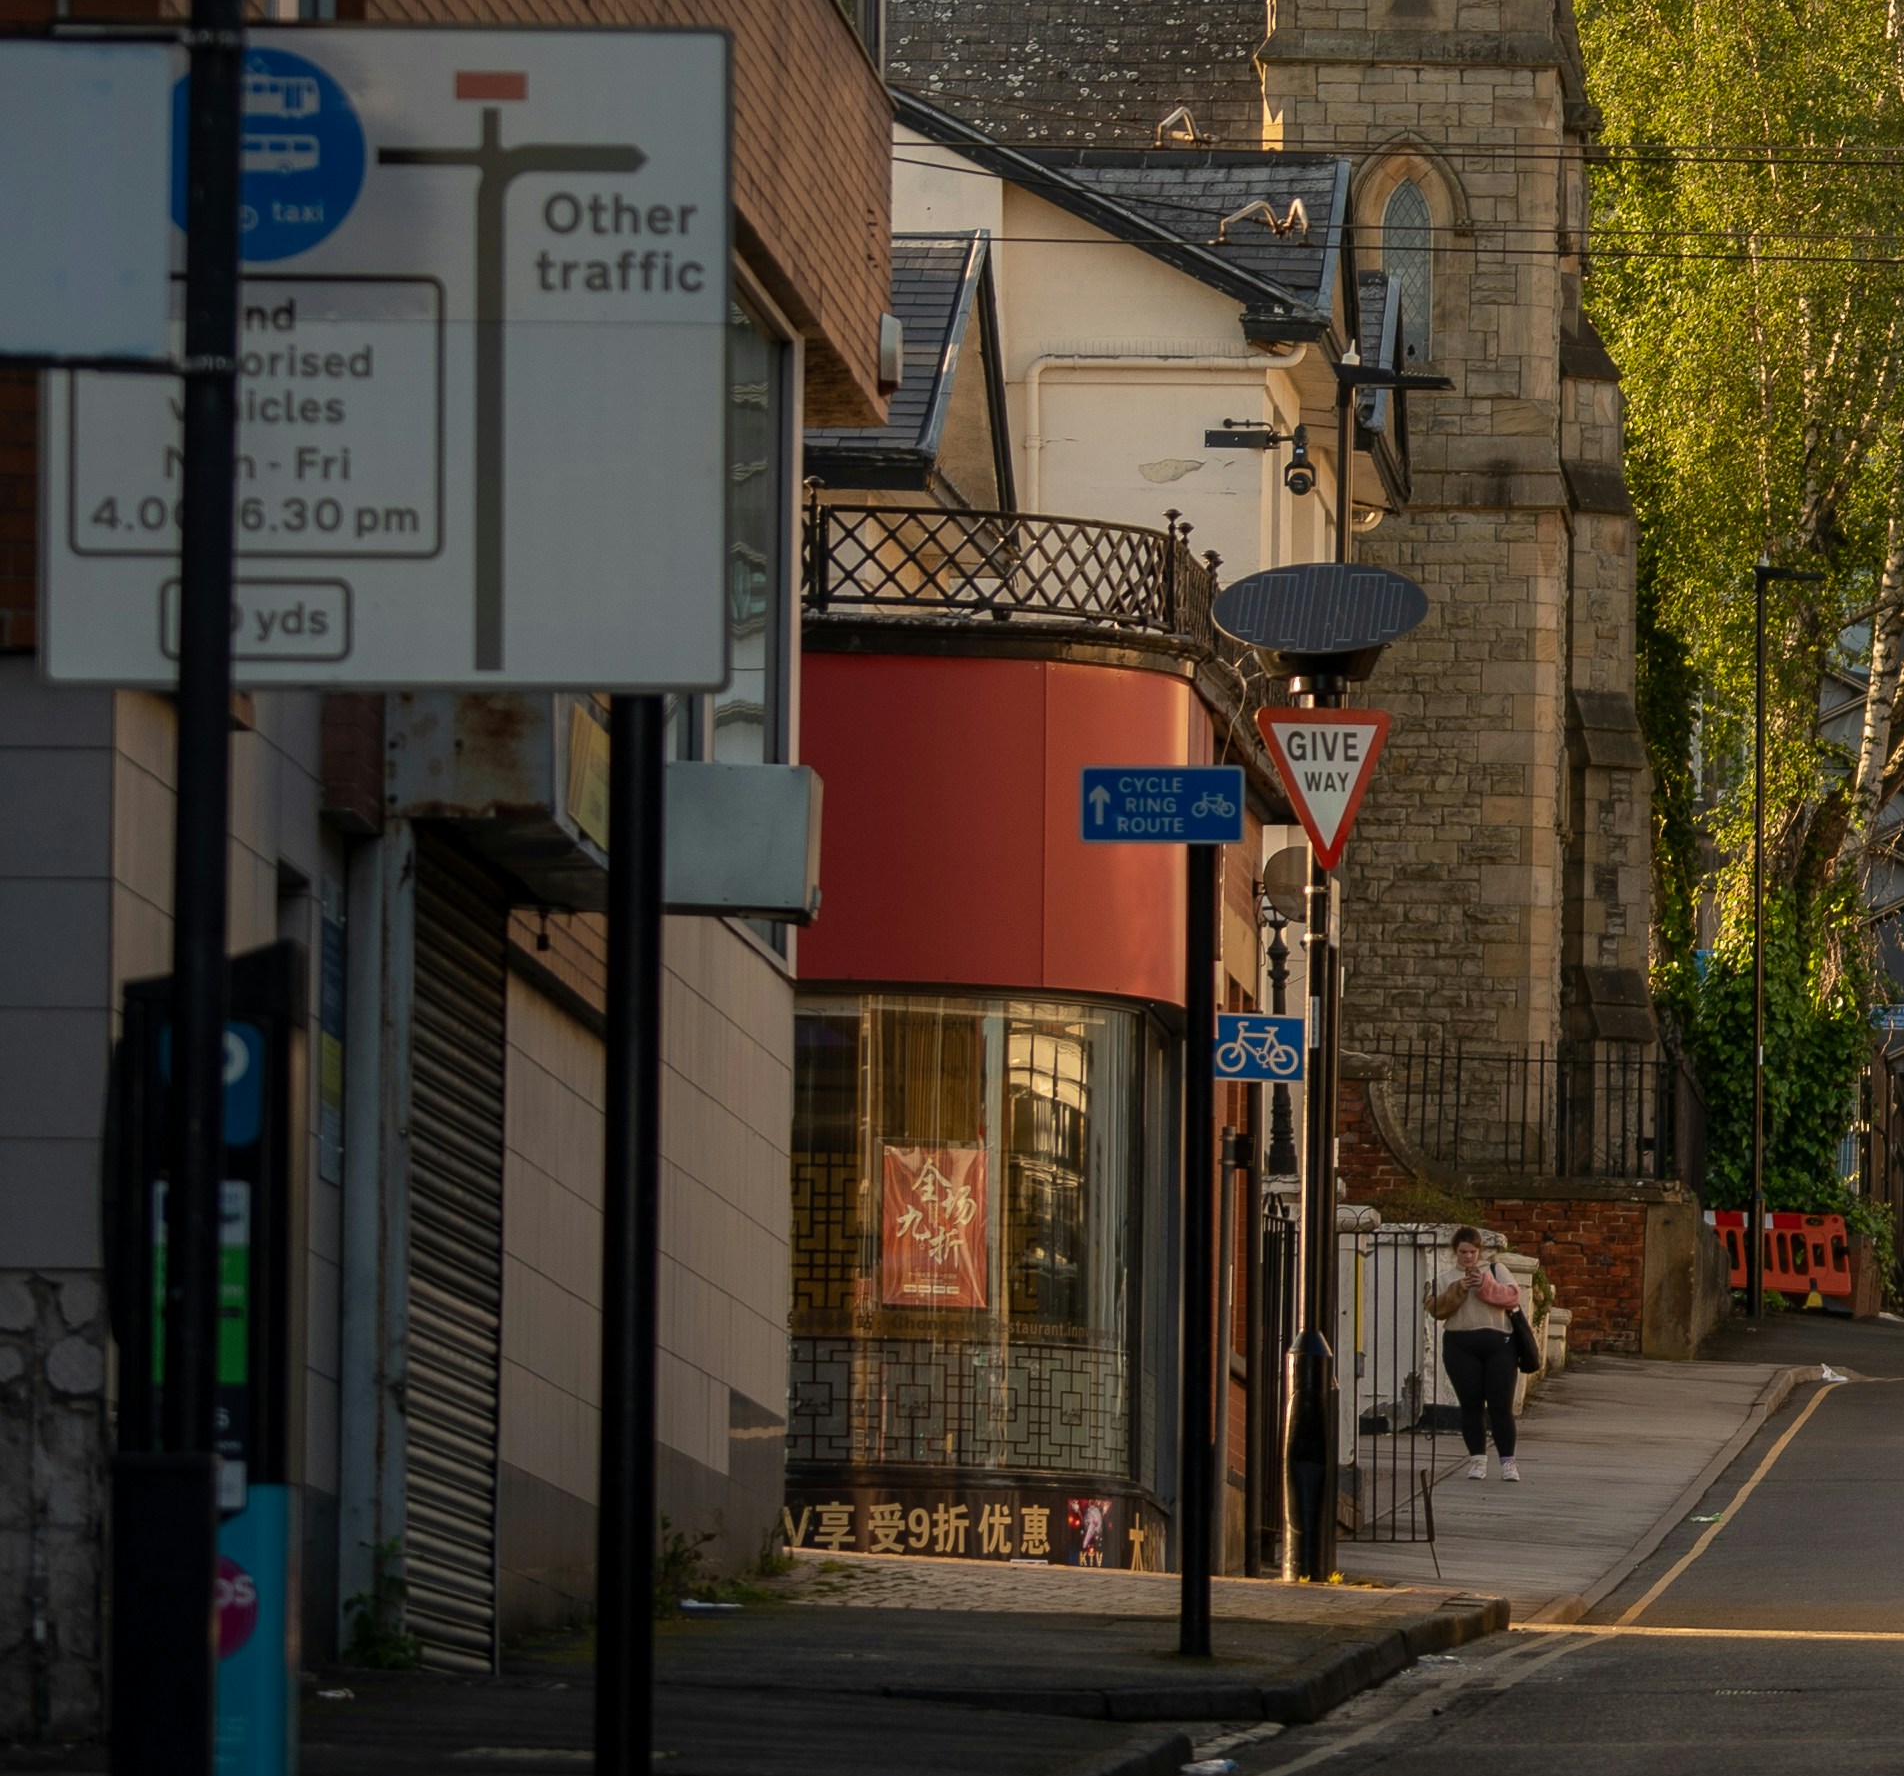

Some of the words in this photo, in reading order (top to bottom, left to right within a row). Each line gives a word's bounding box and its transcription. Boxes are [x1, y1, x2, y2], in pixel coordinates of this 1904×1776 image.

[271, 199, 324, 223] taxi
[543, 191, 698, 236] Other
[536, 249, 707, 293] traffic
[245, 296, 297, 331] nd
[243, 343, 374, 378] orised
[295, 445, 351, 480] Fri
[354, 505, 420, 539] pm
[255, 600, 329, 641] yds
[1287, 730, 1359, 762] GIVE
[1118, 776, 1184, 793] CYCLE
[1304, 771, 1349, 792] WAY
[1125, 797, 1177, 813] RING
[1117, 817, 1184, 833] ROUTE
